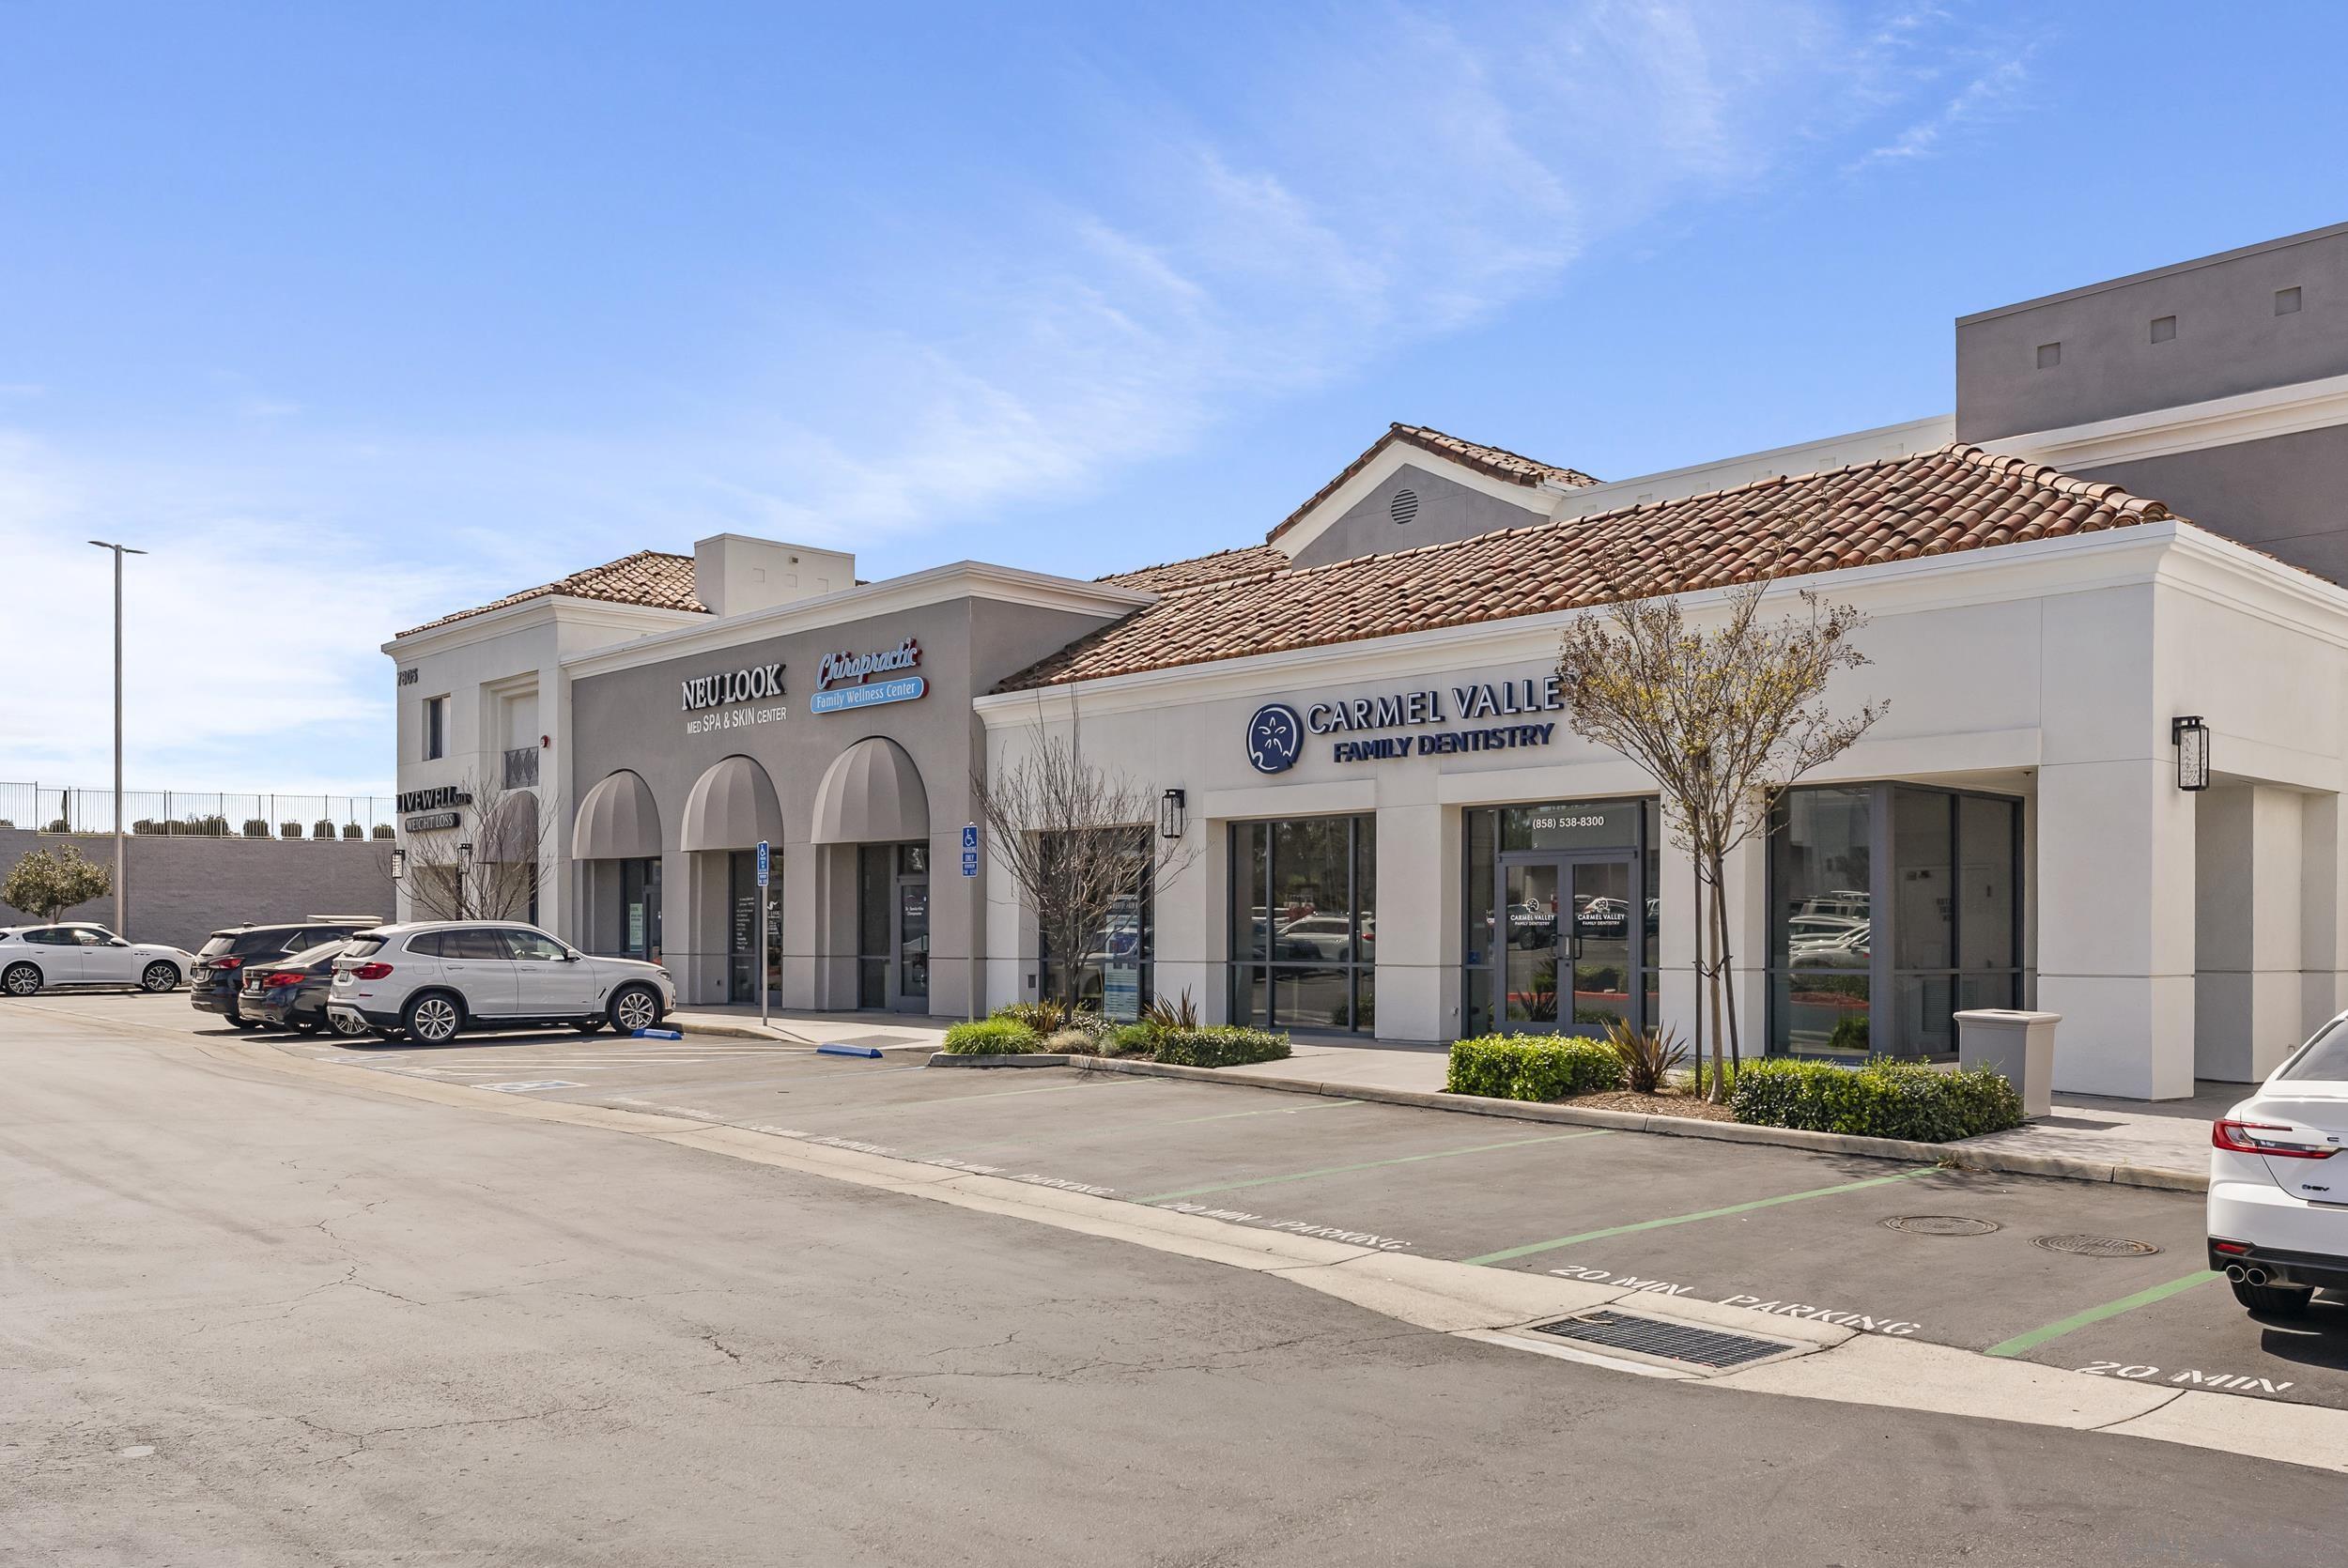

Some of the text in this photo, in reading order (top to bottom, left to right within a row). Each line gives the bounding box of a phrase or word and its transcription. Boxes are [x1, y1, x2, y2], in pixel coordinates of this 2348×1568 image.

[816, 638, 919, 690] Chiropractic
[682, 663, 785, 711] NEU LOOK
[816, 682, 916, 709] Family Wellness Center
[687, 706, 787, 734] MED SPA & SKIN CENTER
[1306, 690, 1445, 735] CARMEL
[1334, 722, 1556, 763] FAMILY DENTISTRY
[436, 813, 455, 828] LOSS
[1532, 816, 1605, 830] (858) 538-8300
[1268, 1219, 1413, 1250] PARKING
[1548, 1264, 1923, 1337] 20 MIN PARKING
[2073, 1360, 2294, 1393] 20 MIN
